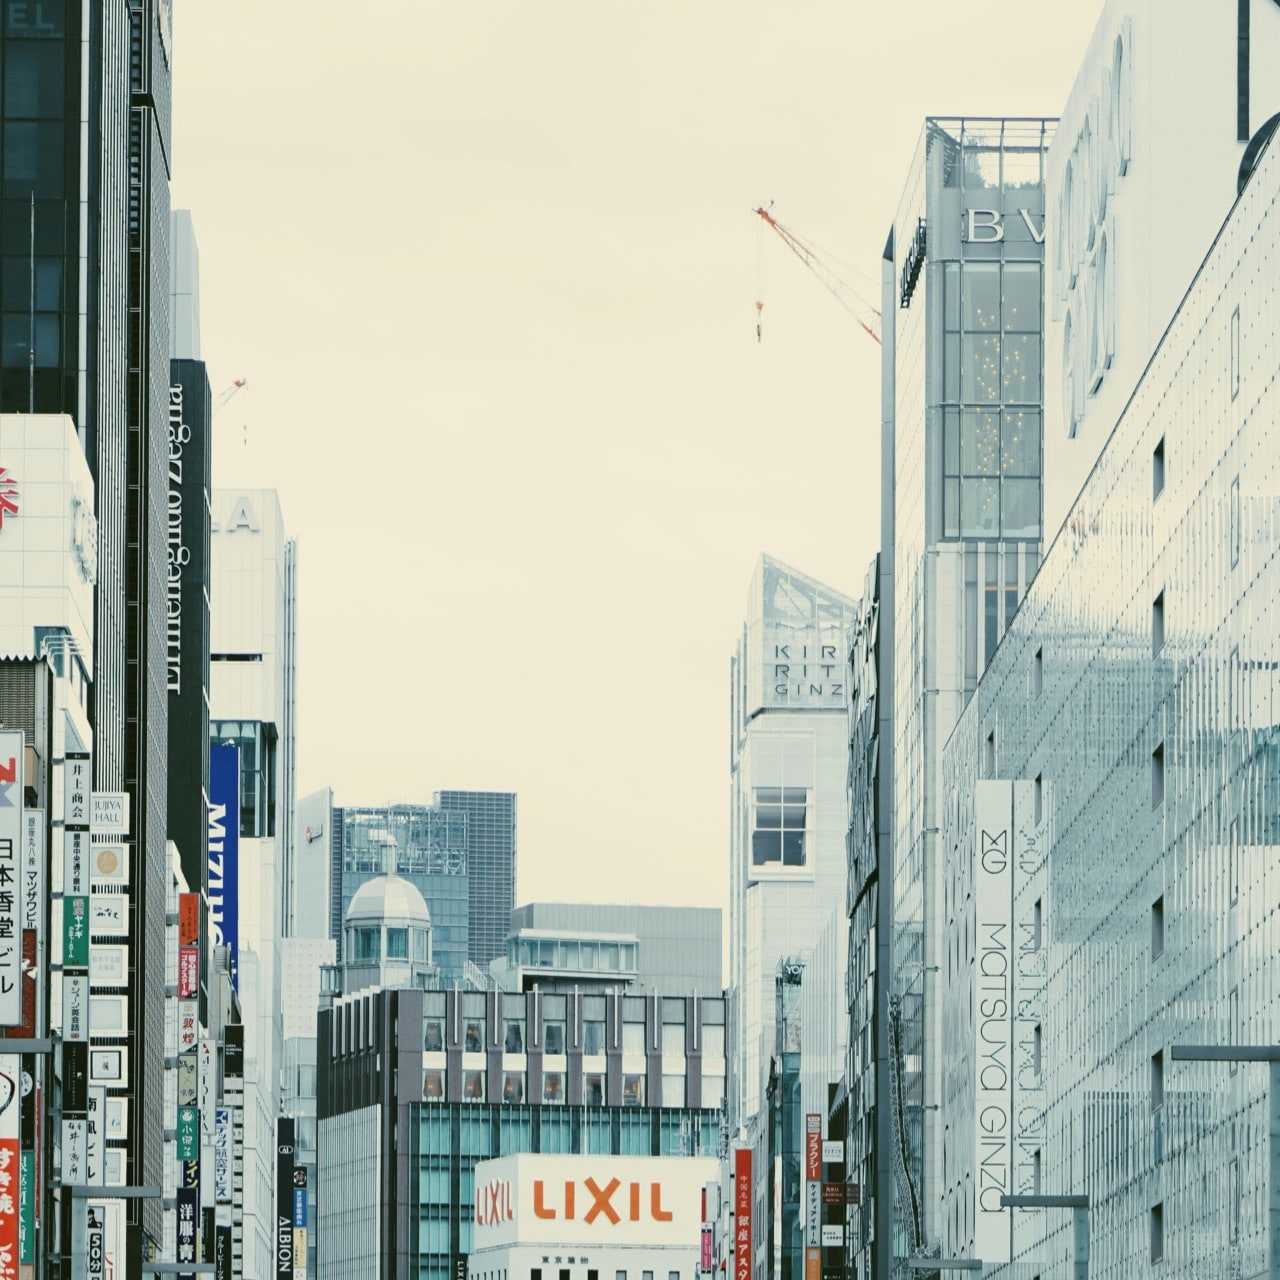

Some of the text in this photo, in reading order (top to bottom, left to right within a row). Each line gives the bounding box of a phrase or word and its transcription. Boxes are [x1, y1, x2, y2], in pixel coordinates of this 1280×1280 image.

[226, 496, 260, 532] A
[94, 801, 121, 811] JUJIYA
[95, 812, 120, 822] HALL
[476, 1177, 513, 1228] LIXIL
[533, 1176, 673, 1225] LIXIL
[279, 1215, 292, 1273] ALBION
